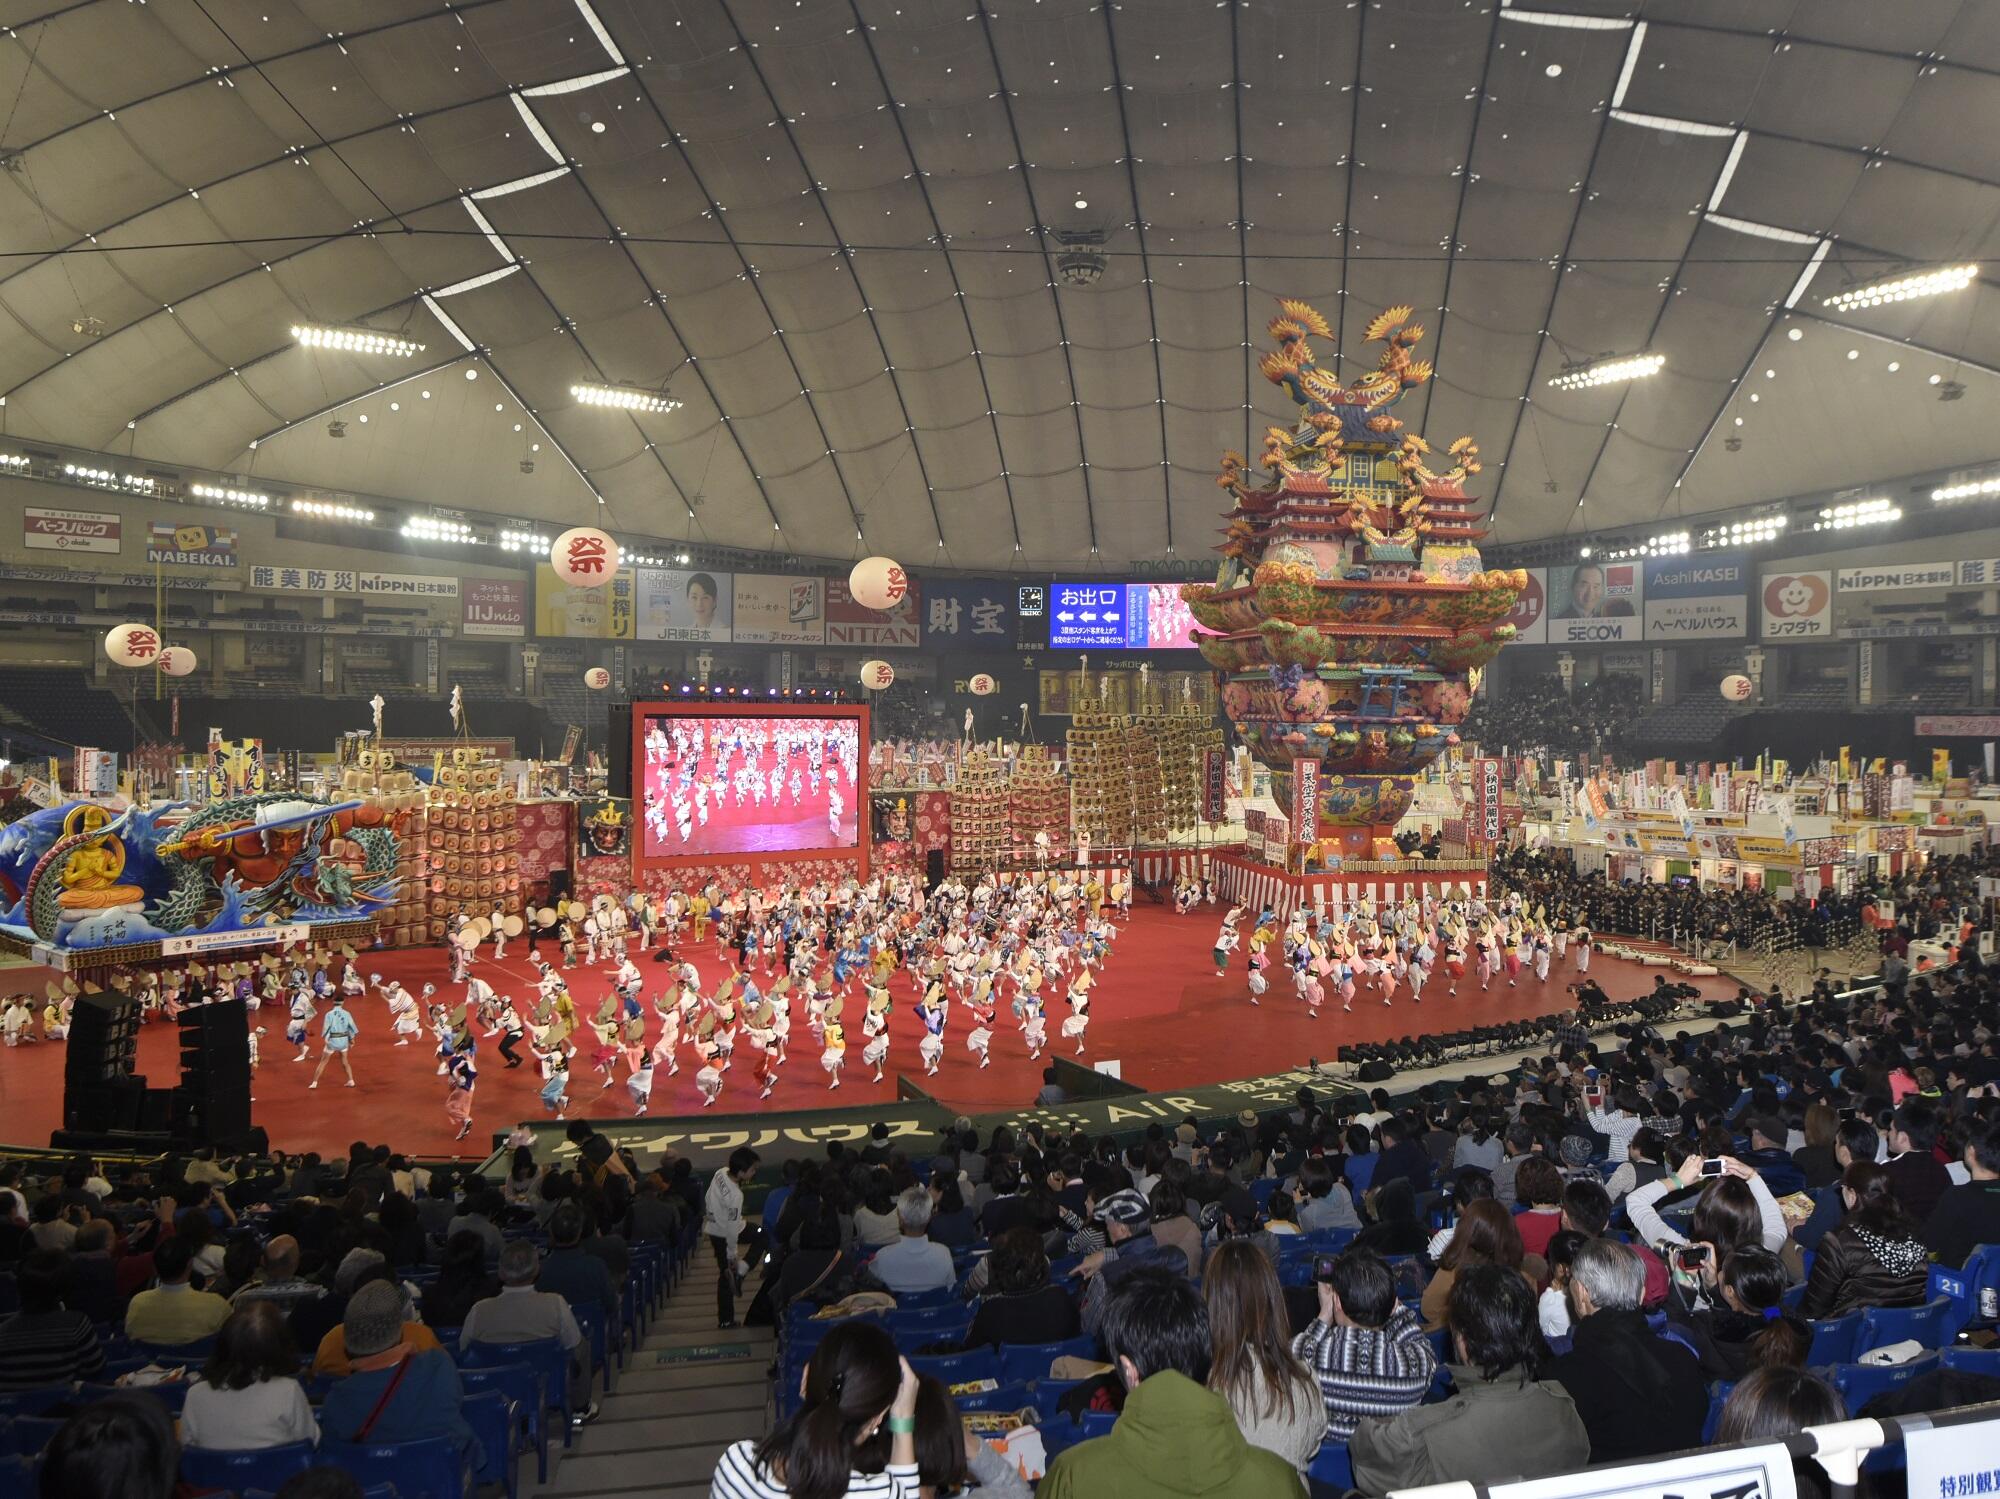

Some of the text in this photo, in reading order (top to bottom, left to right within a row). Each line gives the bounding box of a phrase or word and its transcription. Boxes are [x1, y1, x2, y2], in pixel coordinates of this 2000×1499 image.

[35, 519, 108, 536] ベースパック
[568, 537, 607, 573] 祭
[1130, 560, 1185, 576] TOKYO
[1653, 567, 1740, 586] AsahiKASEI
[252, 567, 353, 590] 能美防災
[1903, 571, 1952, 585] 日本製粉
[417, 582, 457, 594] 日本製粉
[1607, 586, 1633, 595] SECOM
[612, 568, 631, 637] 一番搾り
[1061, 588, 1116, 606] お出口
[468, 605, 521, 623] IIJmio
[928, 598, 1006, 634] 財宝
[1652, 616, 1738, 632] ヘーベルハウス
[1770, 618, 1821, 635] シマダヤ
[658, 628, 711, 641] JR東日本
[829, 626, 917, 644] NITTAN
[1568, 625, 1622, 641] SECOM
[127, 630, 156, 658] 祭
[1105, 660, 1155, 669] サッポロビル
[595, 671, 609, 685] 祭
[876, 665, 893, 683] 祭
[975, 678, 988, 690] 祭
[1301, 772, 1316, 844] 天空の不夜城
[1485, 774, 1498, 840] 秋田県能代市
[1941, 1278, 1959, 1295] 21
